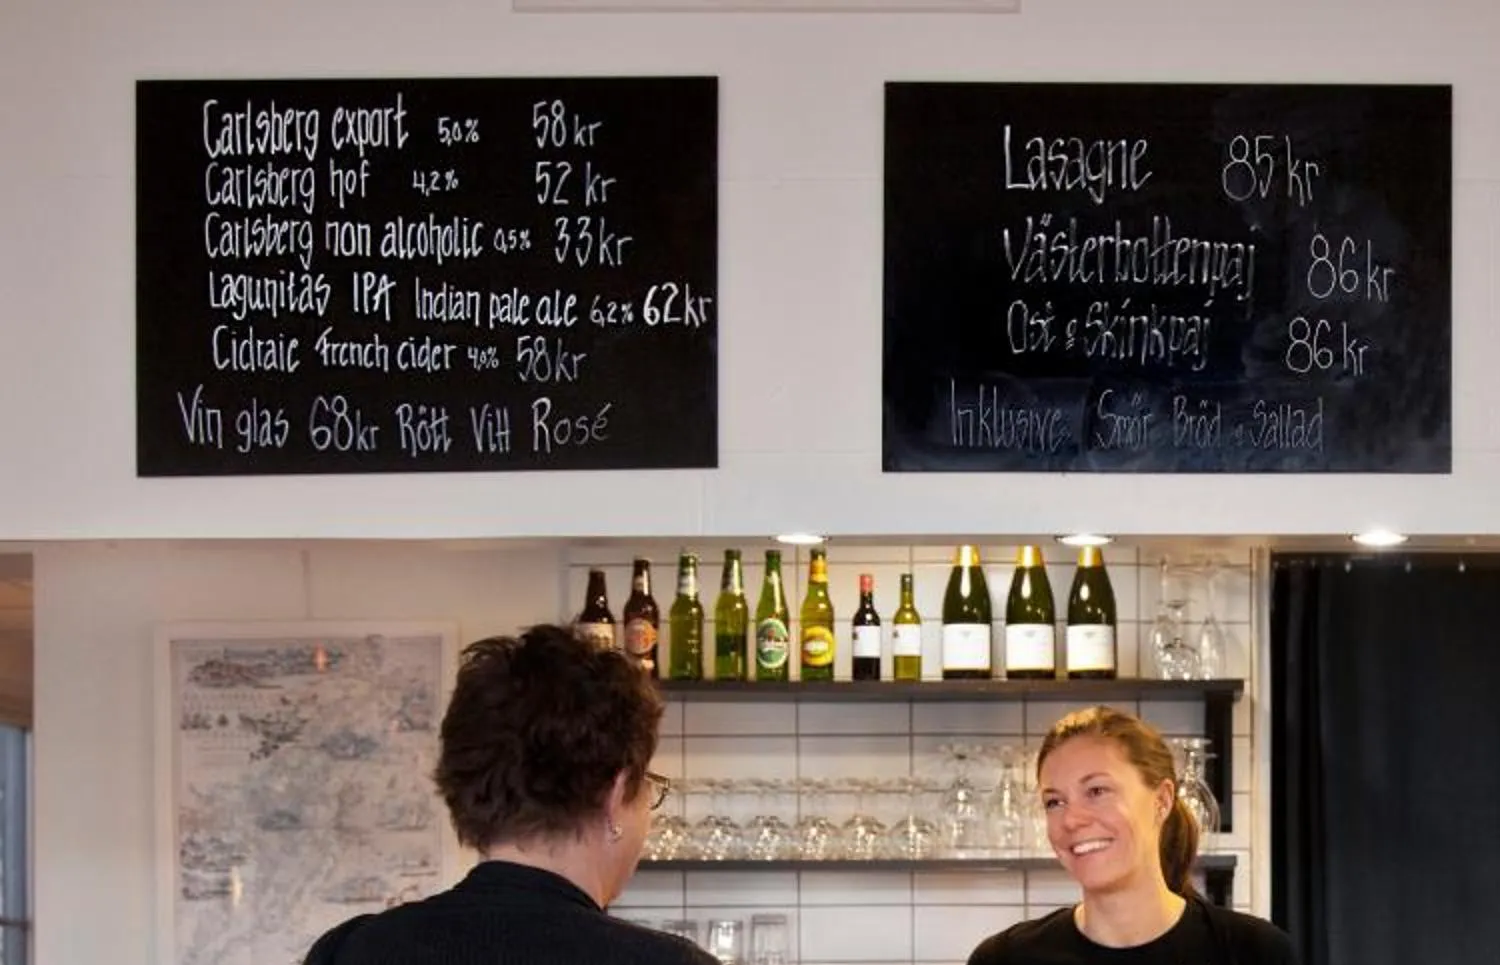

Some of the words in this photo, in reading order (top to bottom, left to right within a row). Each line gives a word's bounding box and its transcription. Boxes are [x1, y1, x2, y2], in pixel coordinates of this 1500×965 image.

[203, 99, 319, 160] Carlsberg
[331, 93, 408, 157] export
[205, 162, 314, 214] Carlsberg
[329, 158, 371, 208] hof
[1004, 124, 1152, 204] Lasagne
[205, 212, 312, 270] Carlsberg
[326, 221, 371, 257] non
[381, 213, 484, 265] alcoholic
[1003, 213, 1256, 302] Västerbottenpaj
[209, 270, 331, 321] Lagunitas
[353, 271, 396, 321] IPA
[415, 277, 480, 327] Indian
[489, 287, 529, 329] pale
[535, 290, 578, 327] ale
[1007, 299, 1055, 355] Ost
[397, 337, 456, 372] cider
[178, 384, 222, 448] Vin
[235, 398, 288, 452] glas
[531, 397, 612, 453] Rosé
